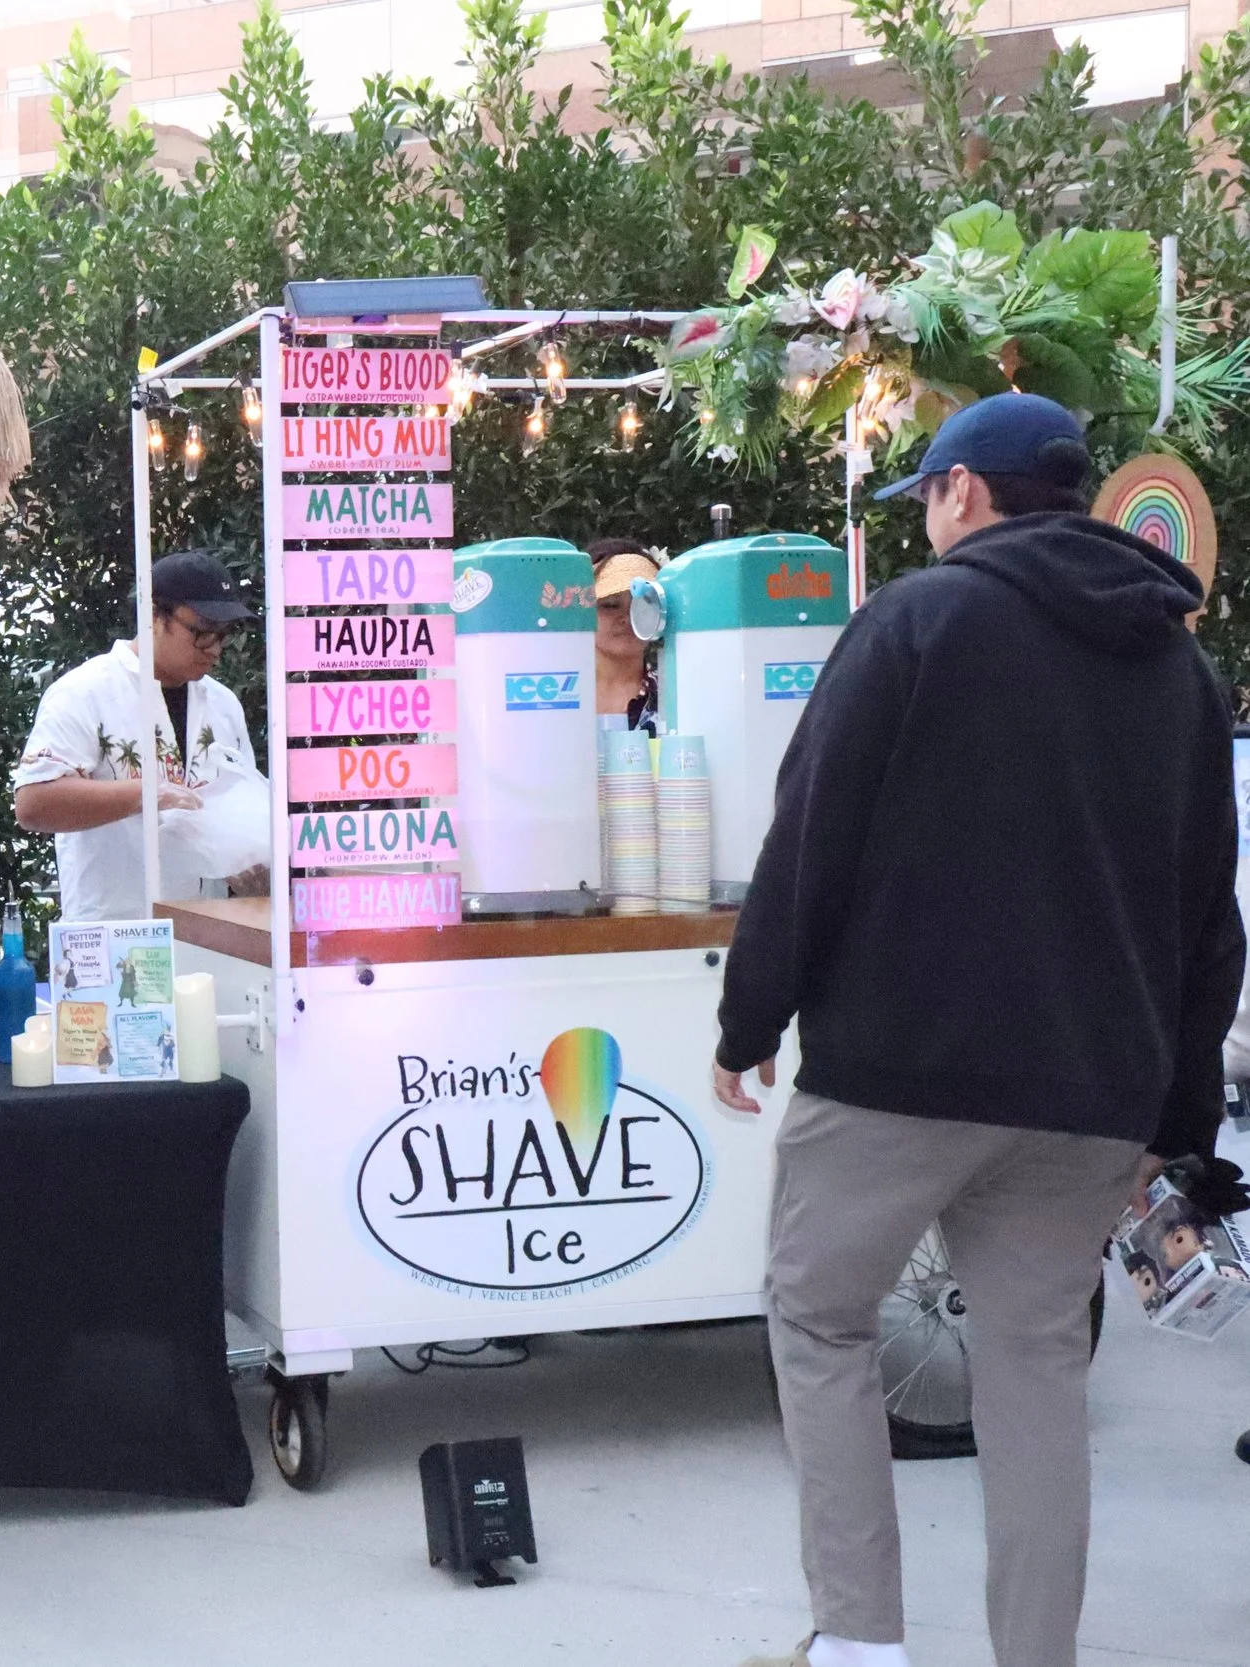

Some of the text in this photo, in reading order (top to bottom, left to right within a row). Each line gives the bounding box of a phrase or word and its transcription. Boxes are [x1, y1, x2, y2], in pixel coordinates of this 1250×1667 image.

[379, 352, 450, 391] BLOOD
[284, 418, 447, 458] LI HING MUI
[306, 486, 432, 525] MATCHA
[317, 553, 415, 603] TARO
[314, 617, 435, 657] HAUPIA
[338, 747, 410, 790] POG
[359, 877, 458, 916] HAWAII
[68, 932, 102, 941] BOTTOM
[70, 940, 101, 949] FEEDER
[114, 926, 170, 938] SHAVE ICE
[70, 1006, 95, 1015] LAVA
[71, 1017, 94, 1025] MAN
[397, 1051, 532, 1105] Brian's
[389, 1113, 661, 1209] SHAVE
[505, 1218, 585, 1275] Ice
[410, 1255, 651, 1301] WEST LA VENICE BEACH CATERING
